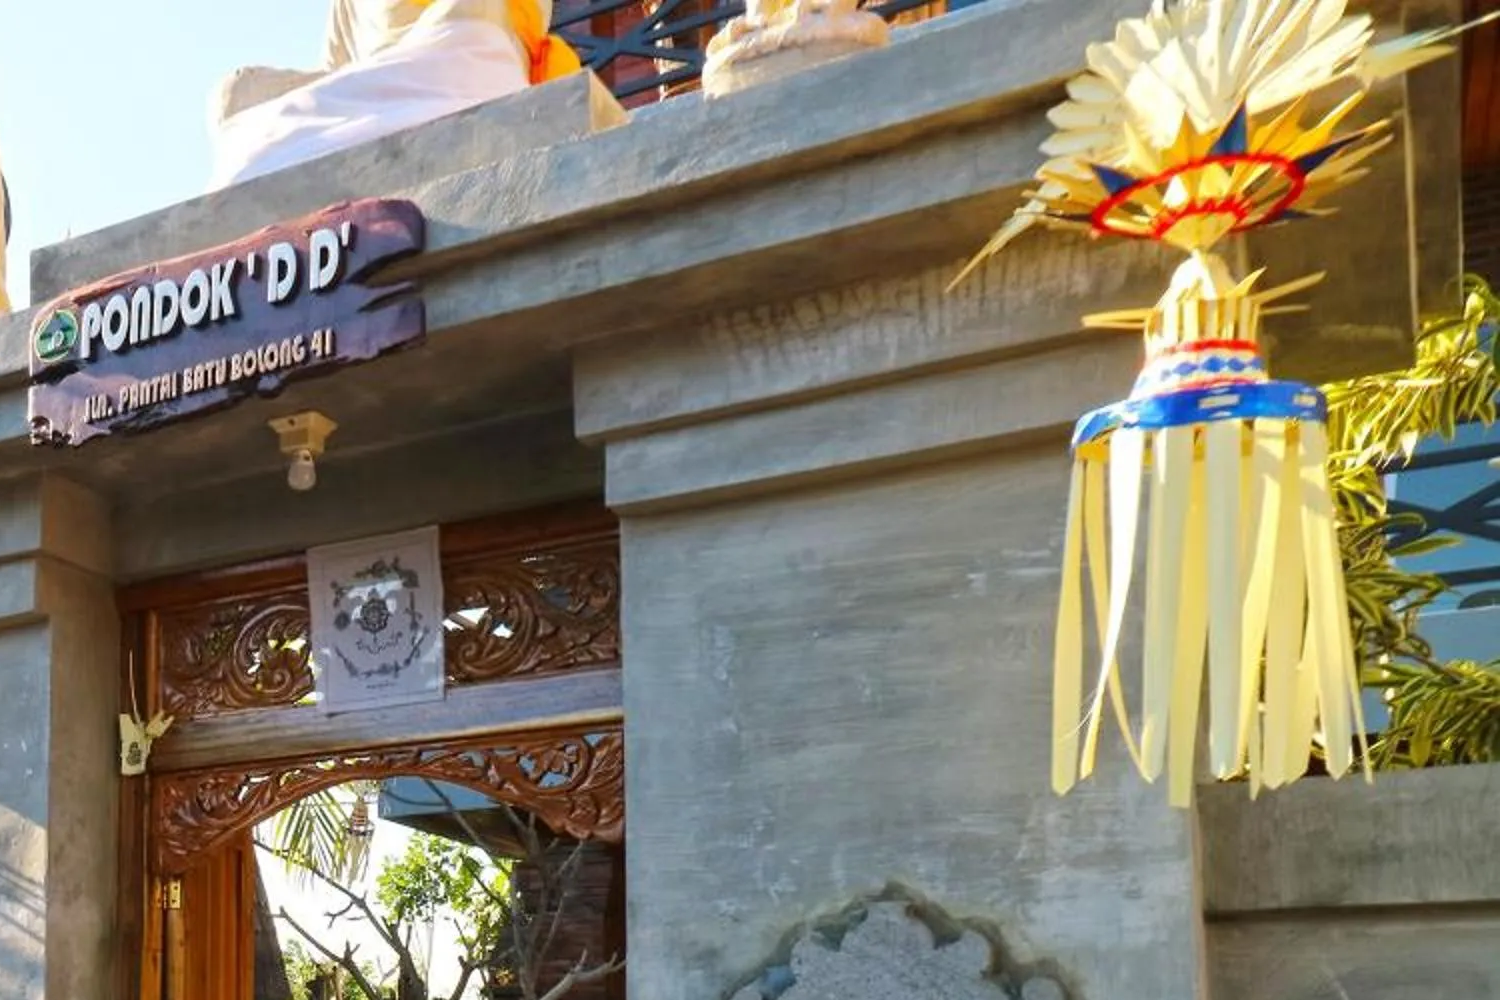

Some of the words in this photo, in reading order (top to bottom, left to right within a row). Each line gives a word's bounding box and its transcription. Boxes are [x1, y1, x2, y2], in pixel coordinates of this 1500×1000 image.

[80, 258, 237, 359] PONDOK
[117, 371, 177, 413] PANTAI
[182, 357, 227, 394] BATU
[231, 335, 305, 381] BOLONG
